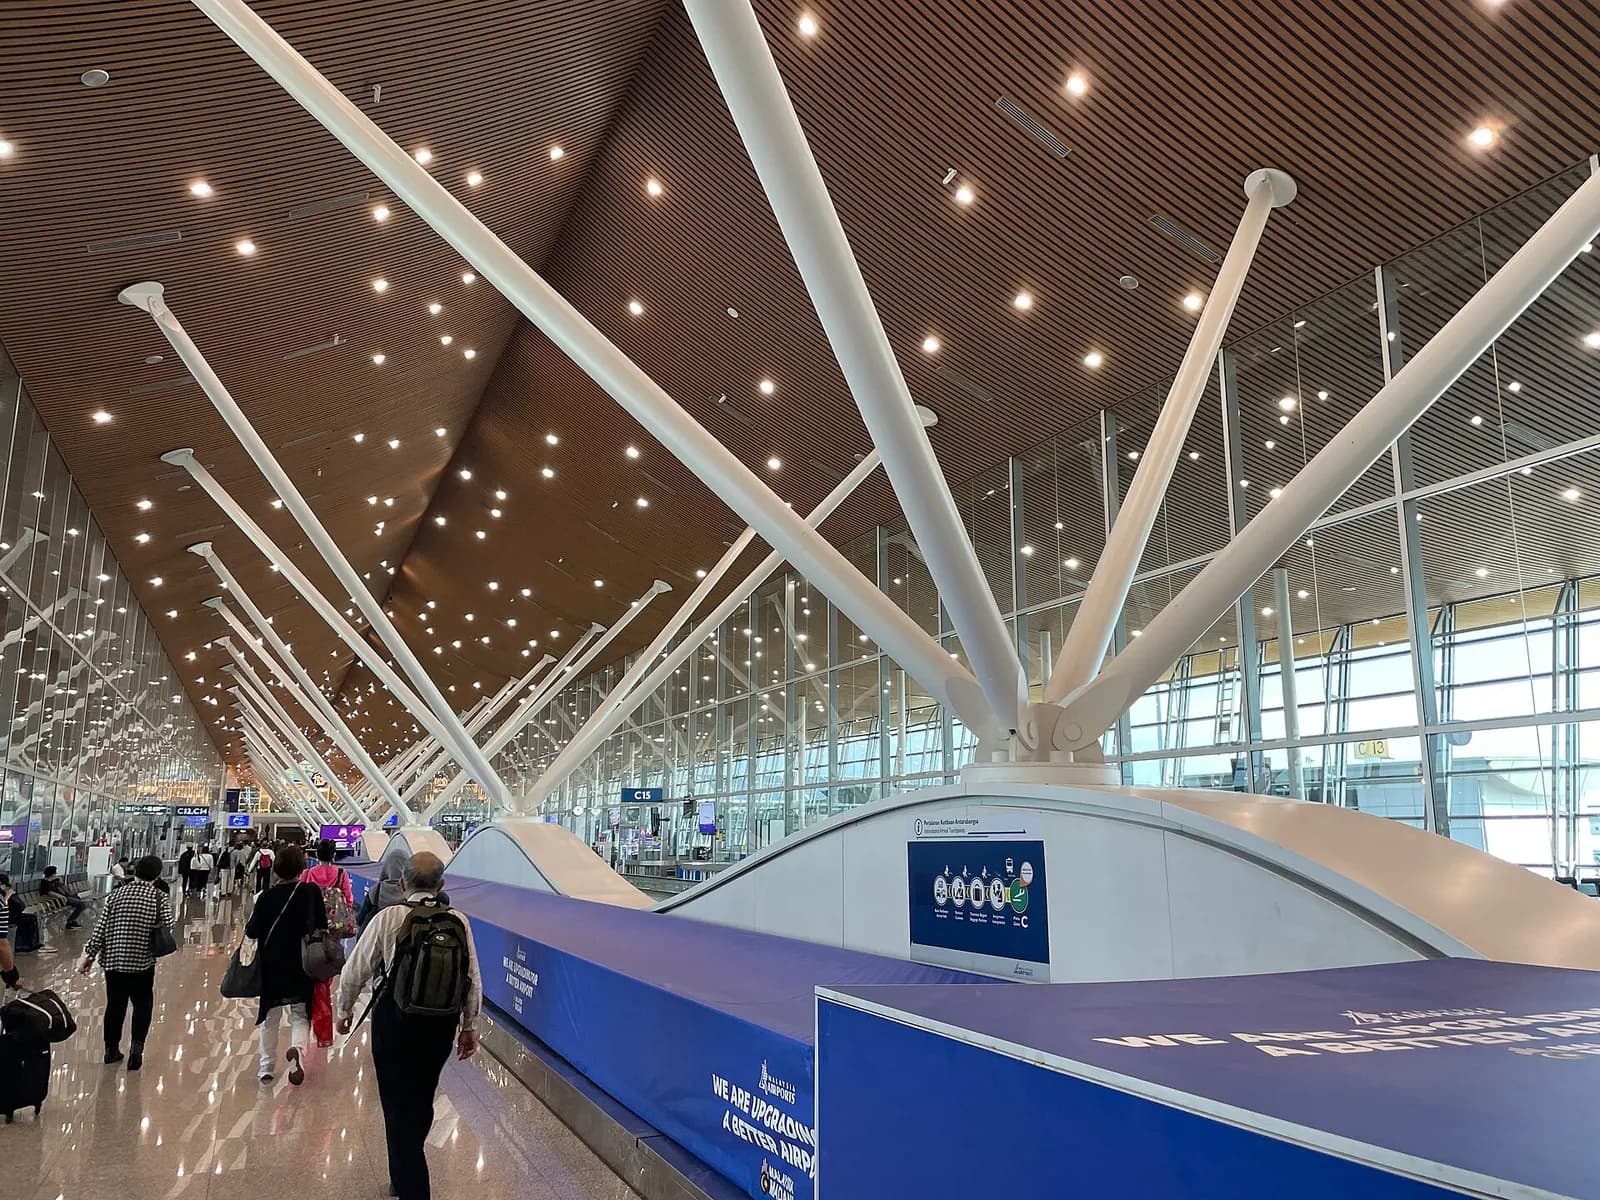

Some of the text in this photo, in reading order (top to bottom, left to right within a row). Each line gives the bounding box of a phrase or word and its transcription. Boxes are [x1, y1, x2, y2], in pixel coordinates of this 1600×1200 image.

[1372, 741, 1385, 754] 13
[634, 791, 651, 800] C15
[1021, 915, 1029, 928] C
[1092, 1032, 1228, 1049] WE
[1230, 1030, 1365, 1043] ARE
[1255, 1044, 1321, 1057] A
[1303, 1031, 1549, 1054] BETTER
[712, 1074, 729, 1101] WE
[730, 1084, 751, 1114] ARE
[768, 1082, 796, 1104] AIRPORTS
[723, 1110, 731, 1132] A
[731, 1115, 779, 1156] BETTER
